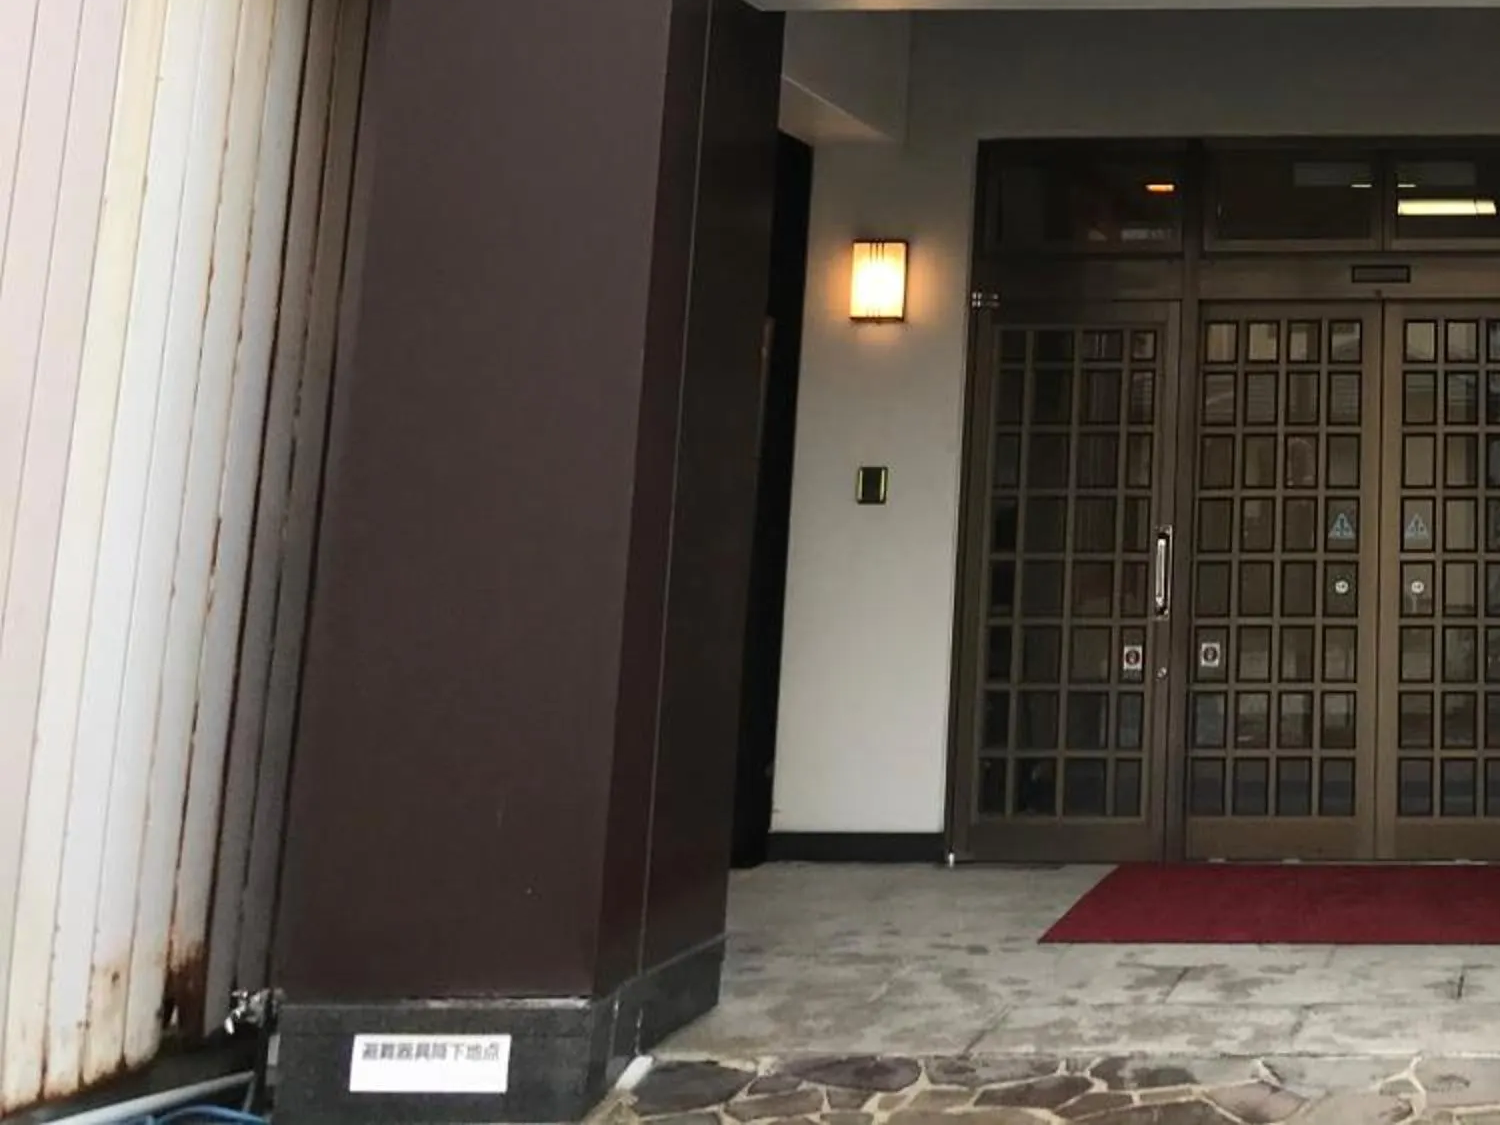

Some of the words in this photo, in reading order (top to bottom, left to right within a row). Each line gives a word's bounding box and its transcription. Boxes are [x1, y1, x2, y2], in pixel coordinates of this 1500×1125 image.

[361, 1041, 500, 1062] 避難器具降下地点
